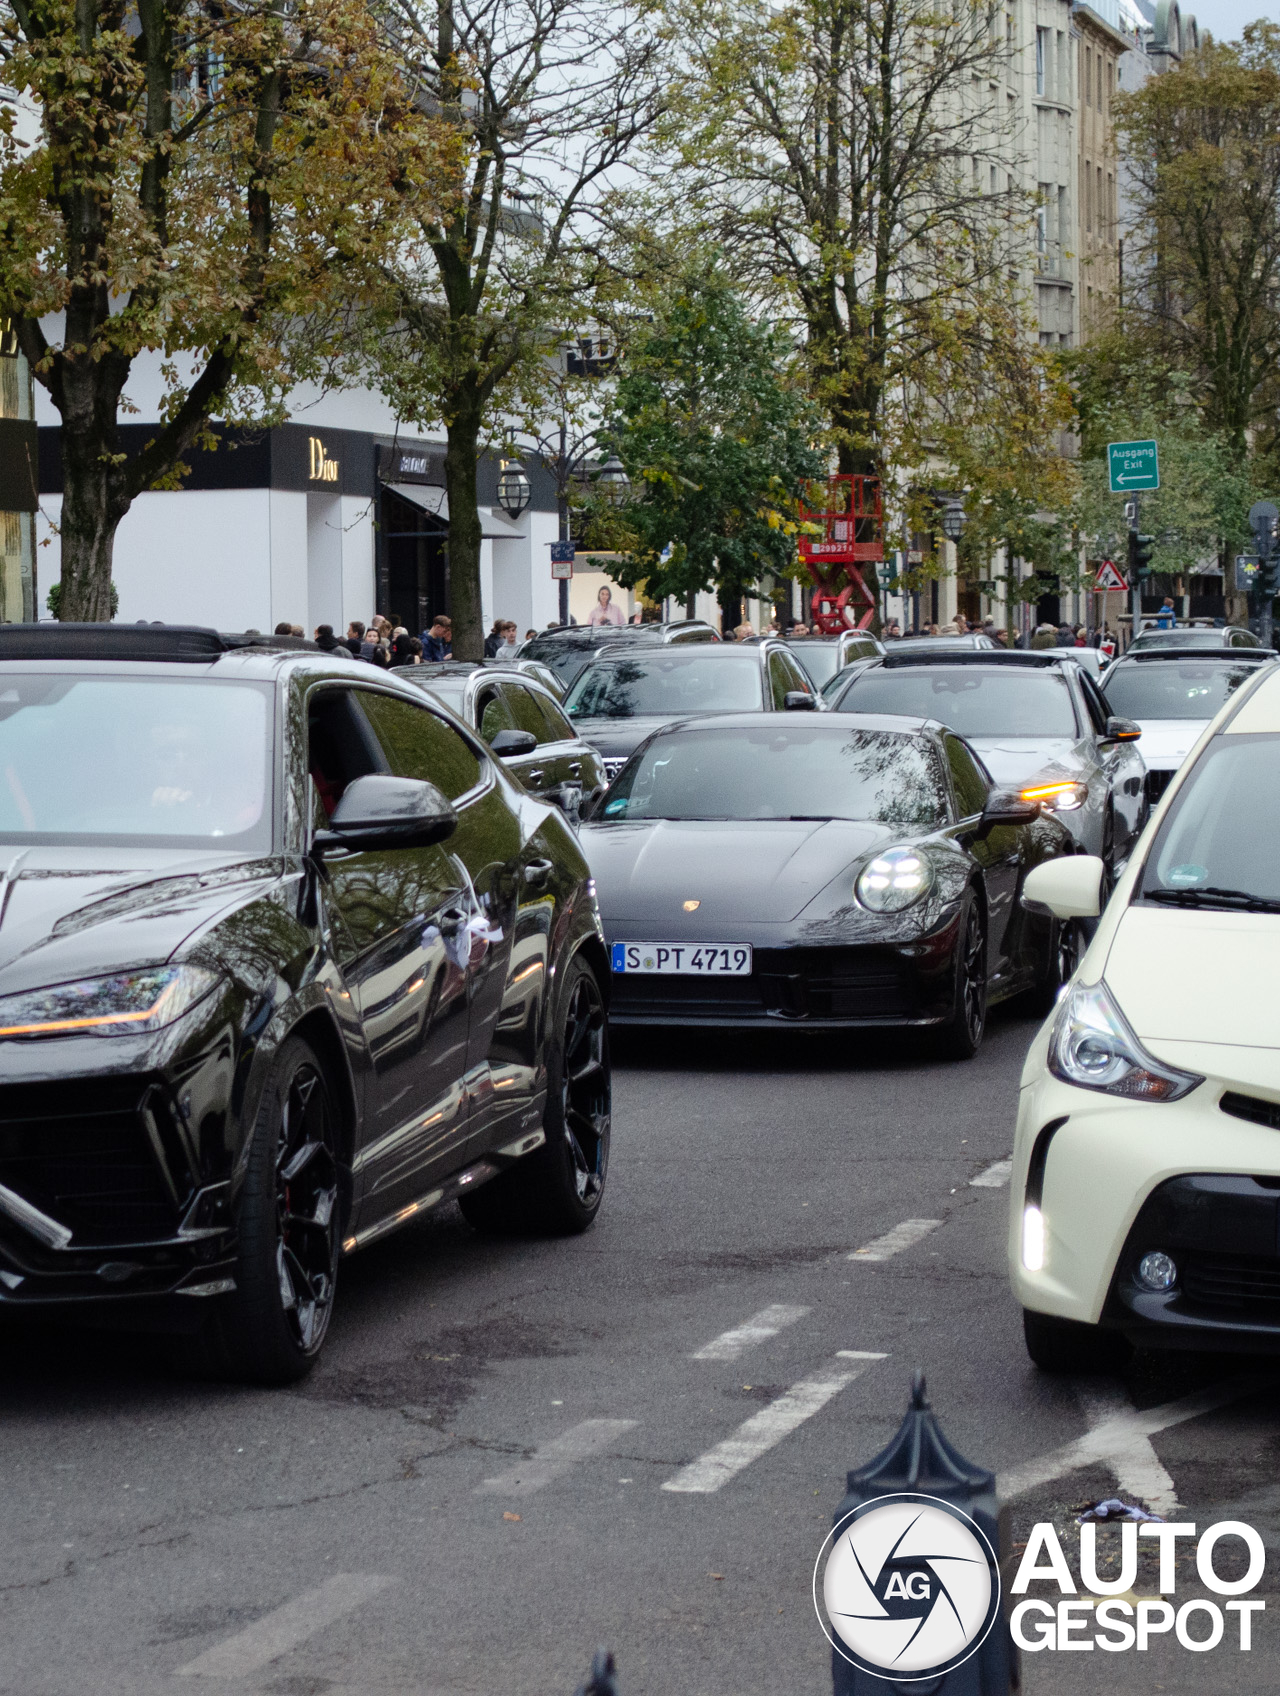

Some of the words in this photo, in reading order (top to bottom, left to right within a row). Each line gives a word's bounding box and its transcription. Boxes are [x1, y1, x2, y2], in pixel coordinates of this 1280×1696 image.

[308, 436, 340, 482] Dior
[1112, 448, 1154, 459] Ausgang
[1123, 460, 1143, 470] Exit
[626, 947, 641, 969] S
[656, 948, 686, 970] PT
[691, 949, 747, 971] 4719
